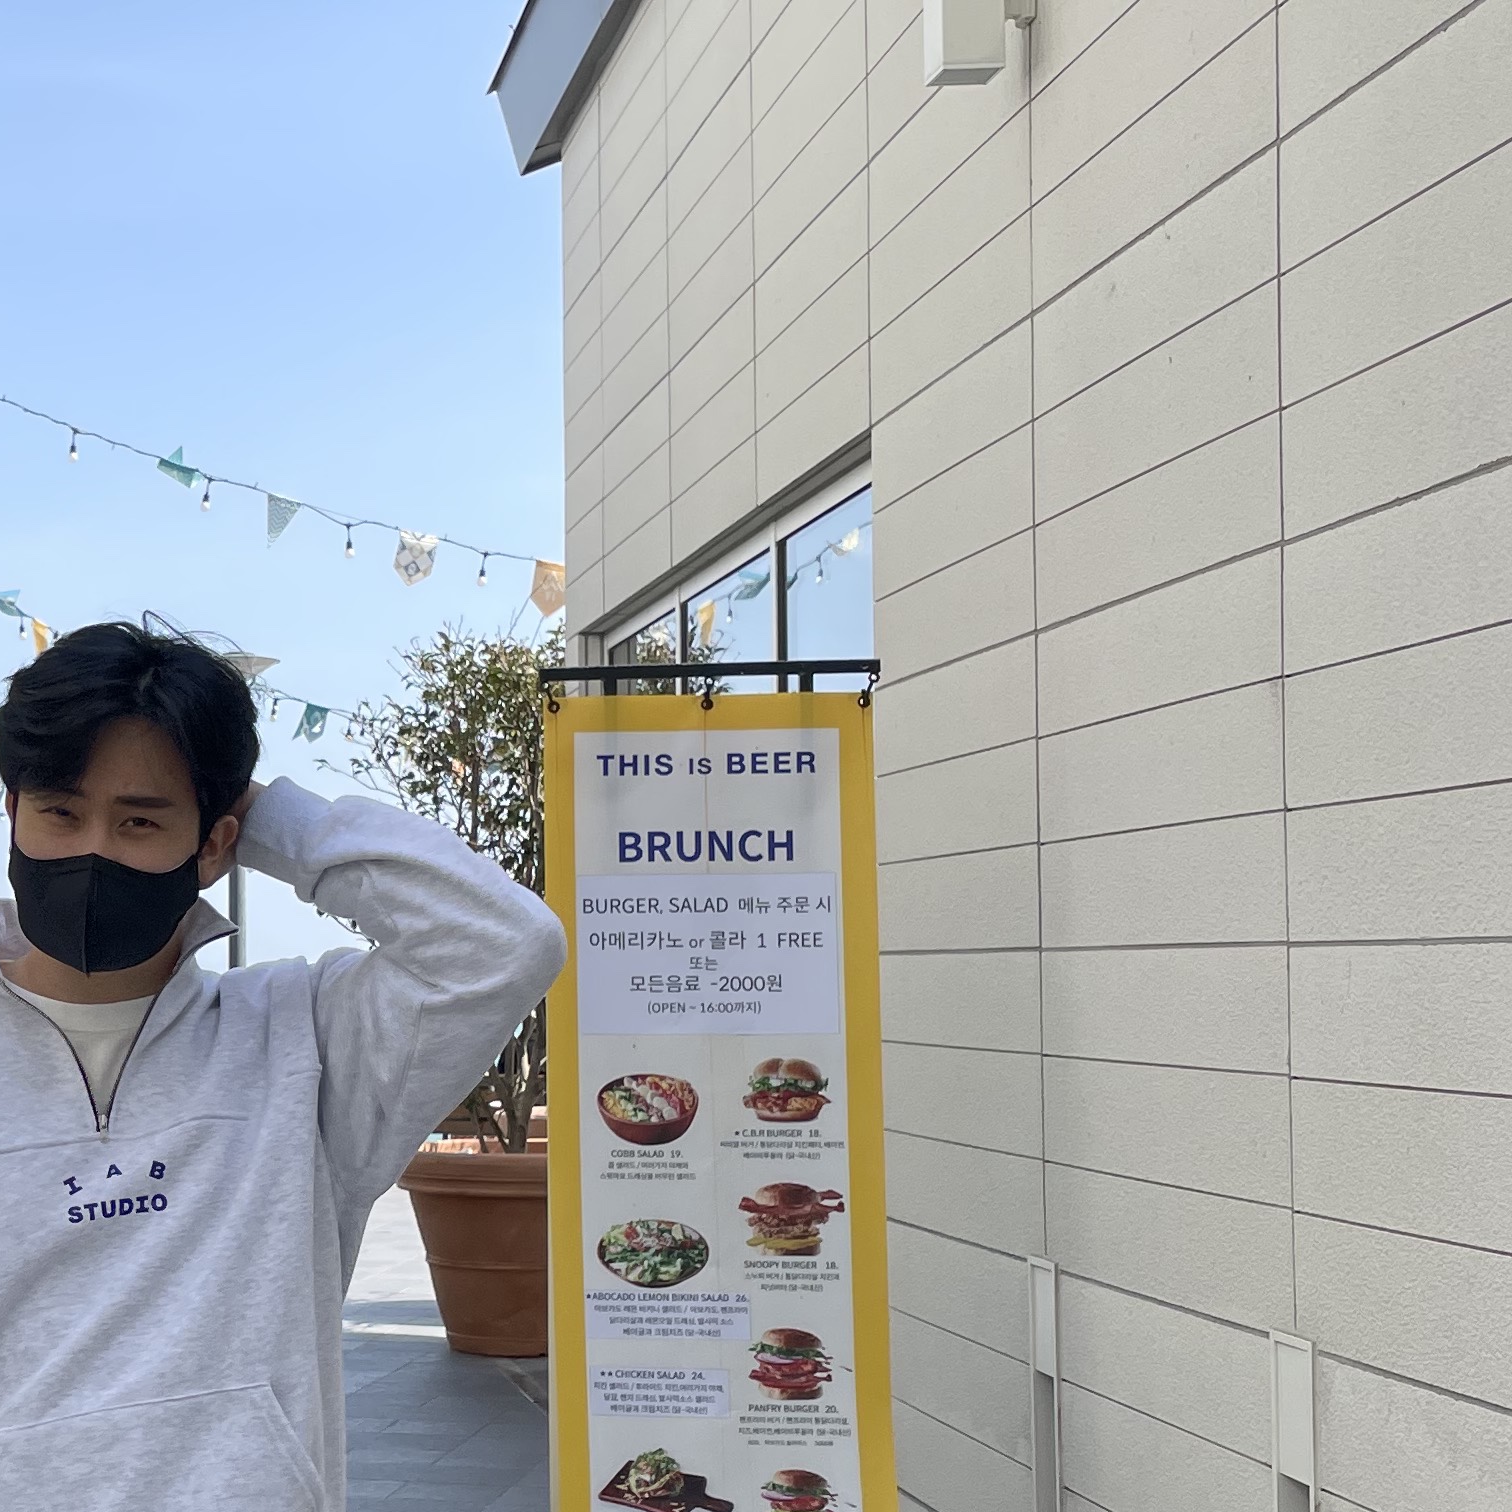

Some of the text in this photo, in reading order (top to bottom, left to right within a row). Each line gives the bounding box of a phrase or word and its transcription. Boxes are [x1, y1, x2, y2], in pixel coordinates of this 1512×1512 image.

[596, 753, 674, 777] THIS
[726, 751, 816, 775] BEER
[618, 829, 795, 863] BRUNCH
[582, 894, 832, 915] BURGER, SALAD 메뉴 주문 시
[589, 930, 824, 950] 아메리카노 or 콜라 1 FREE
[689, 955, 718, 971] 또는
[629, 973, 783, 993] 모든음료 -2000원
[647, 1001, 686, 1014] (OPEN
[767, 1129, 802, 1138] BURGER
[610, 1149, 635, 1158] COBB
[637, 1149, 664, 1158] SALAD
[67, 1193, 168, 1224] STUDIO
[744, 1260, 779, 1268] SNOOPY
[781, 1261, 817, 1269] BURGER
[638, 1293, 669, 1301] LEMON
[671, 1293, 698, 1301] BIKINI
[700, 1294, 730, 1302] SALAD
[615, 1370, 655, 1378] CHICKEN
[657, 1371, 686, 1379] SALAD
[748, 1404, 782, 1412] PANFRY
[784, 1405, 819, 1413] BURGER
